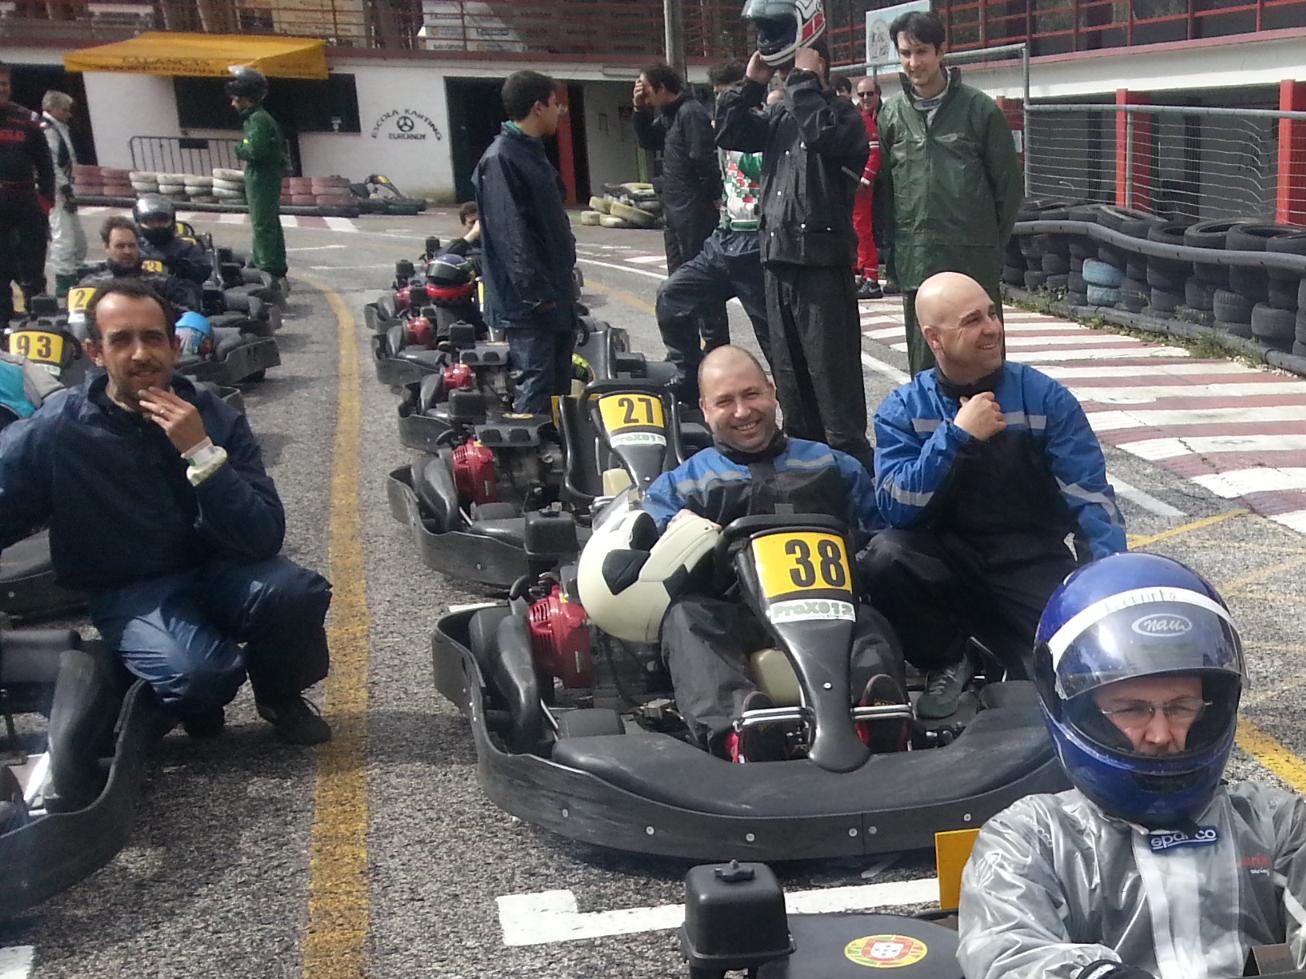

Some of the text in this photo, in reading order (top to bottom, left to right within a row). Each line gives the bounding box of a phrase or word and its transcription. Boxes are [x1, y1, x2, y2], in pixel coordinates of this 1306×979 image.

[371, 109, 399, 139] ESCOLA
[17, 335, 52, 358] 93
[618, 397, 654, 424] 27
[785, 539, 846, 587] 38
